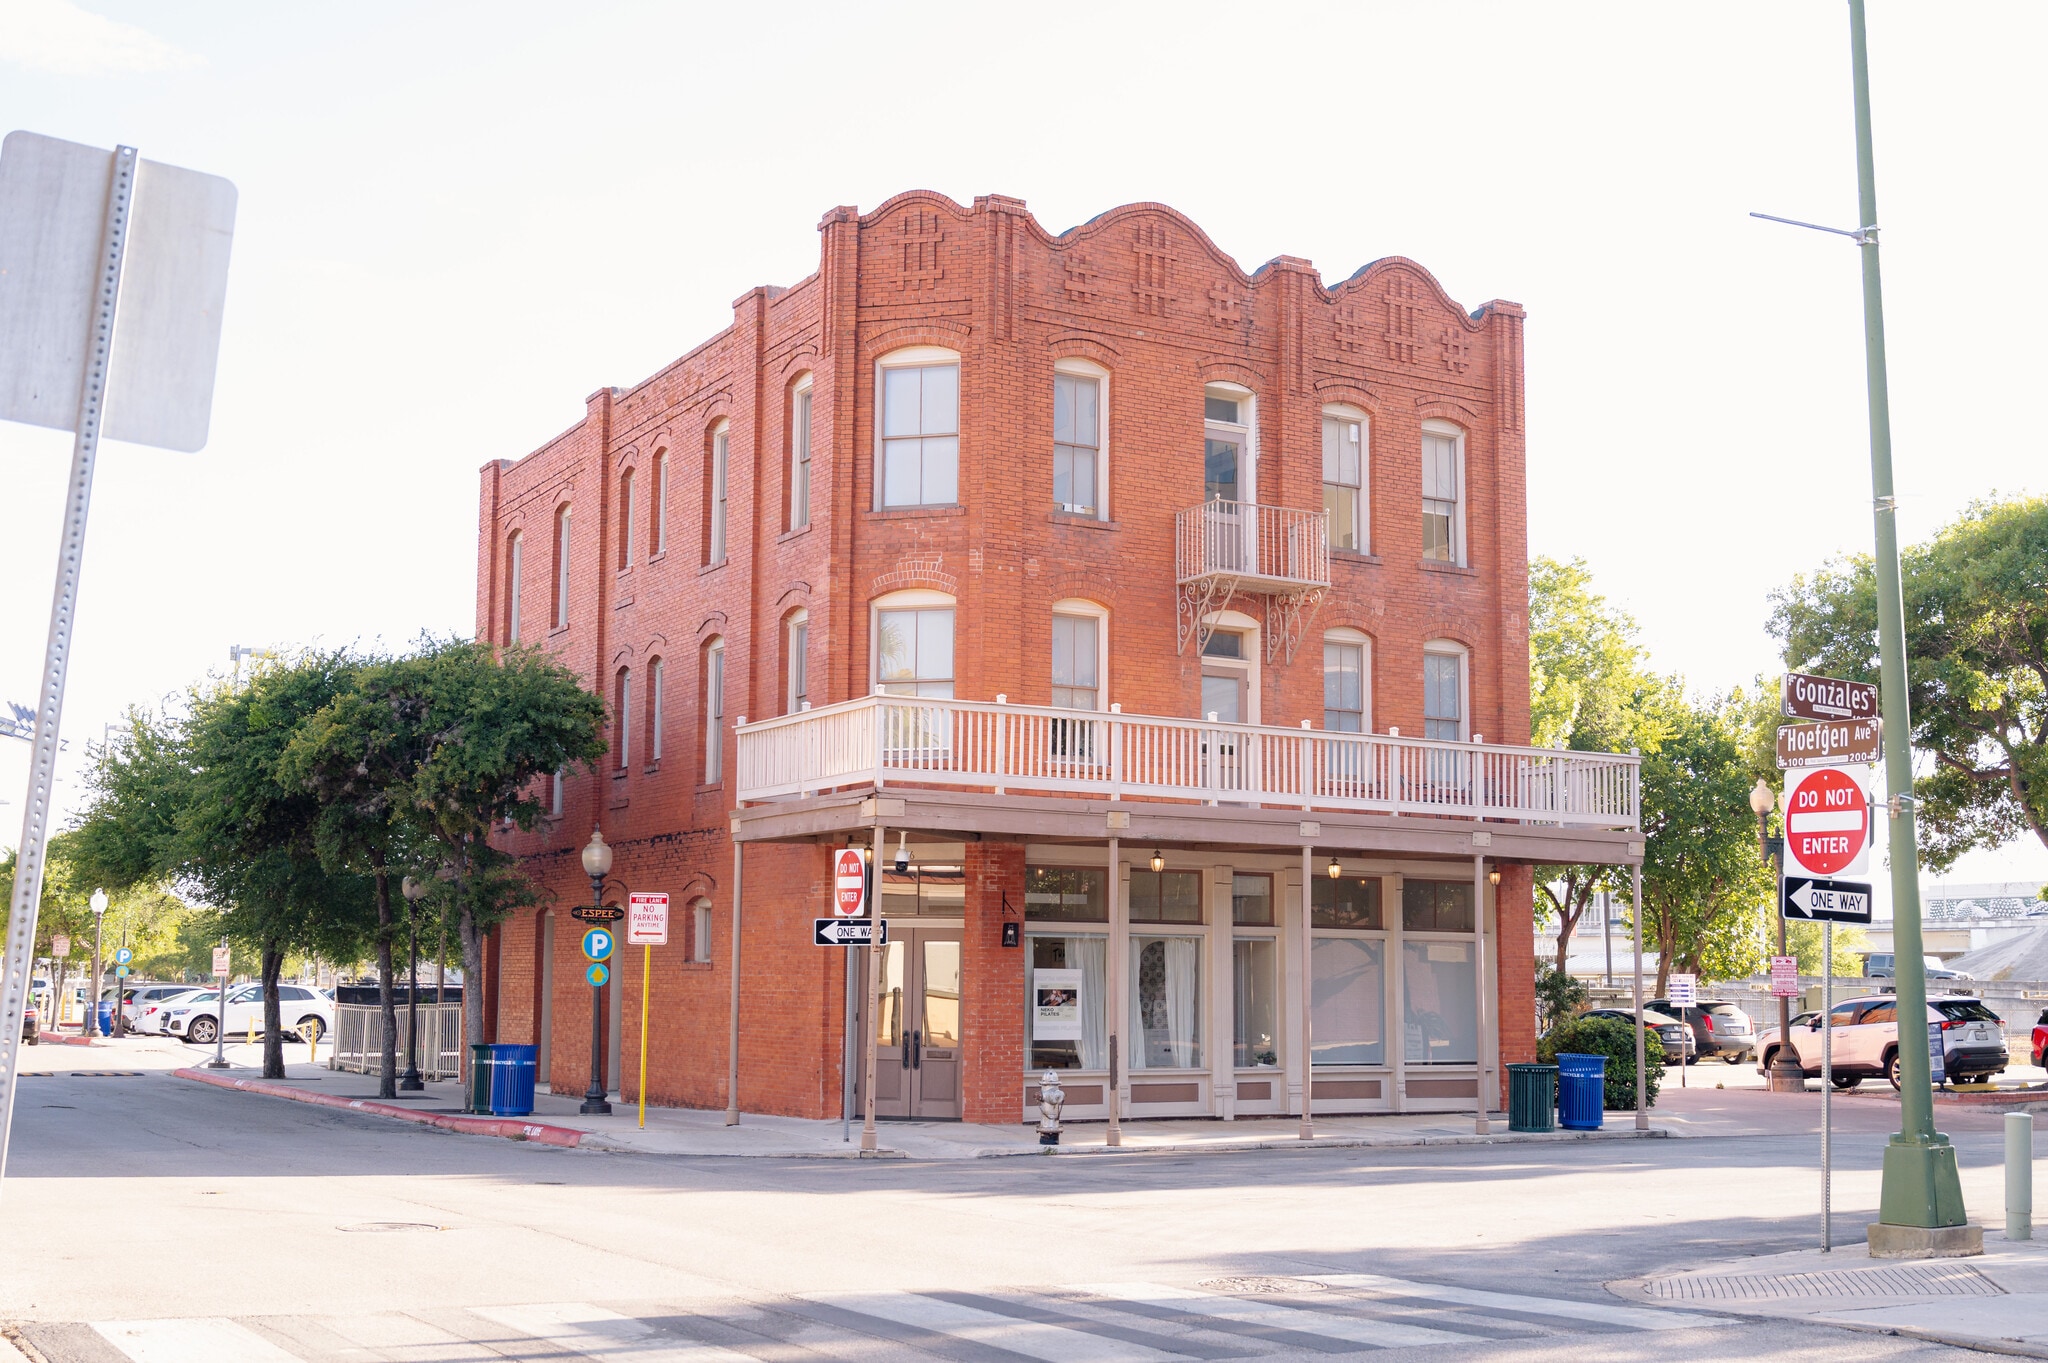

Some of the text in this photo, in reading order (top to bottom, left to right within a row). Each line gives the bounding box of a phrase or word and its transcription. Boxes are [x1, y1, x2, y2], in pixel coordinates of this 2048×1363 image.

[1796, 677, 1869, 711] Gonzales
[1787, 724, 1871, 755] Hoefgen Ave
[1788, 758, 1804, 767] 100
[1849, 752, 1867, 762] 200
[1799, 788, 1854, 808] DO NOT
[1802, 837, 1849, 855] ENTER
[840, 862, 860, 874] DO NOT
[841, 892, 858, 902] ENTER
[1811, 891, 1863, 911] ONE WAY
[582, 909, 615, 918] ESPEE
[642, 905, 655, 913] NO
[633, 913, 664, 922] PARKING
[836, 927, 856, 937] ONE
[591, 933, 609, 957] P
[119, 949, 131, 963] P
